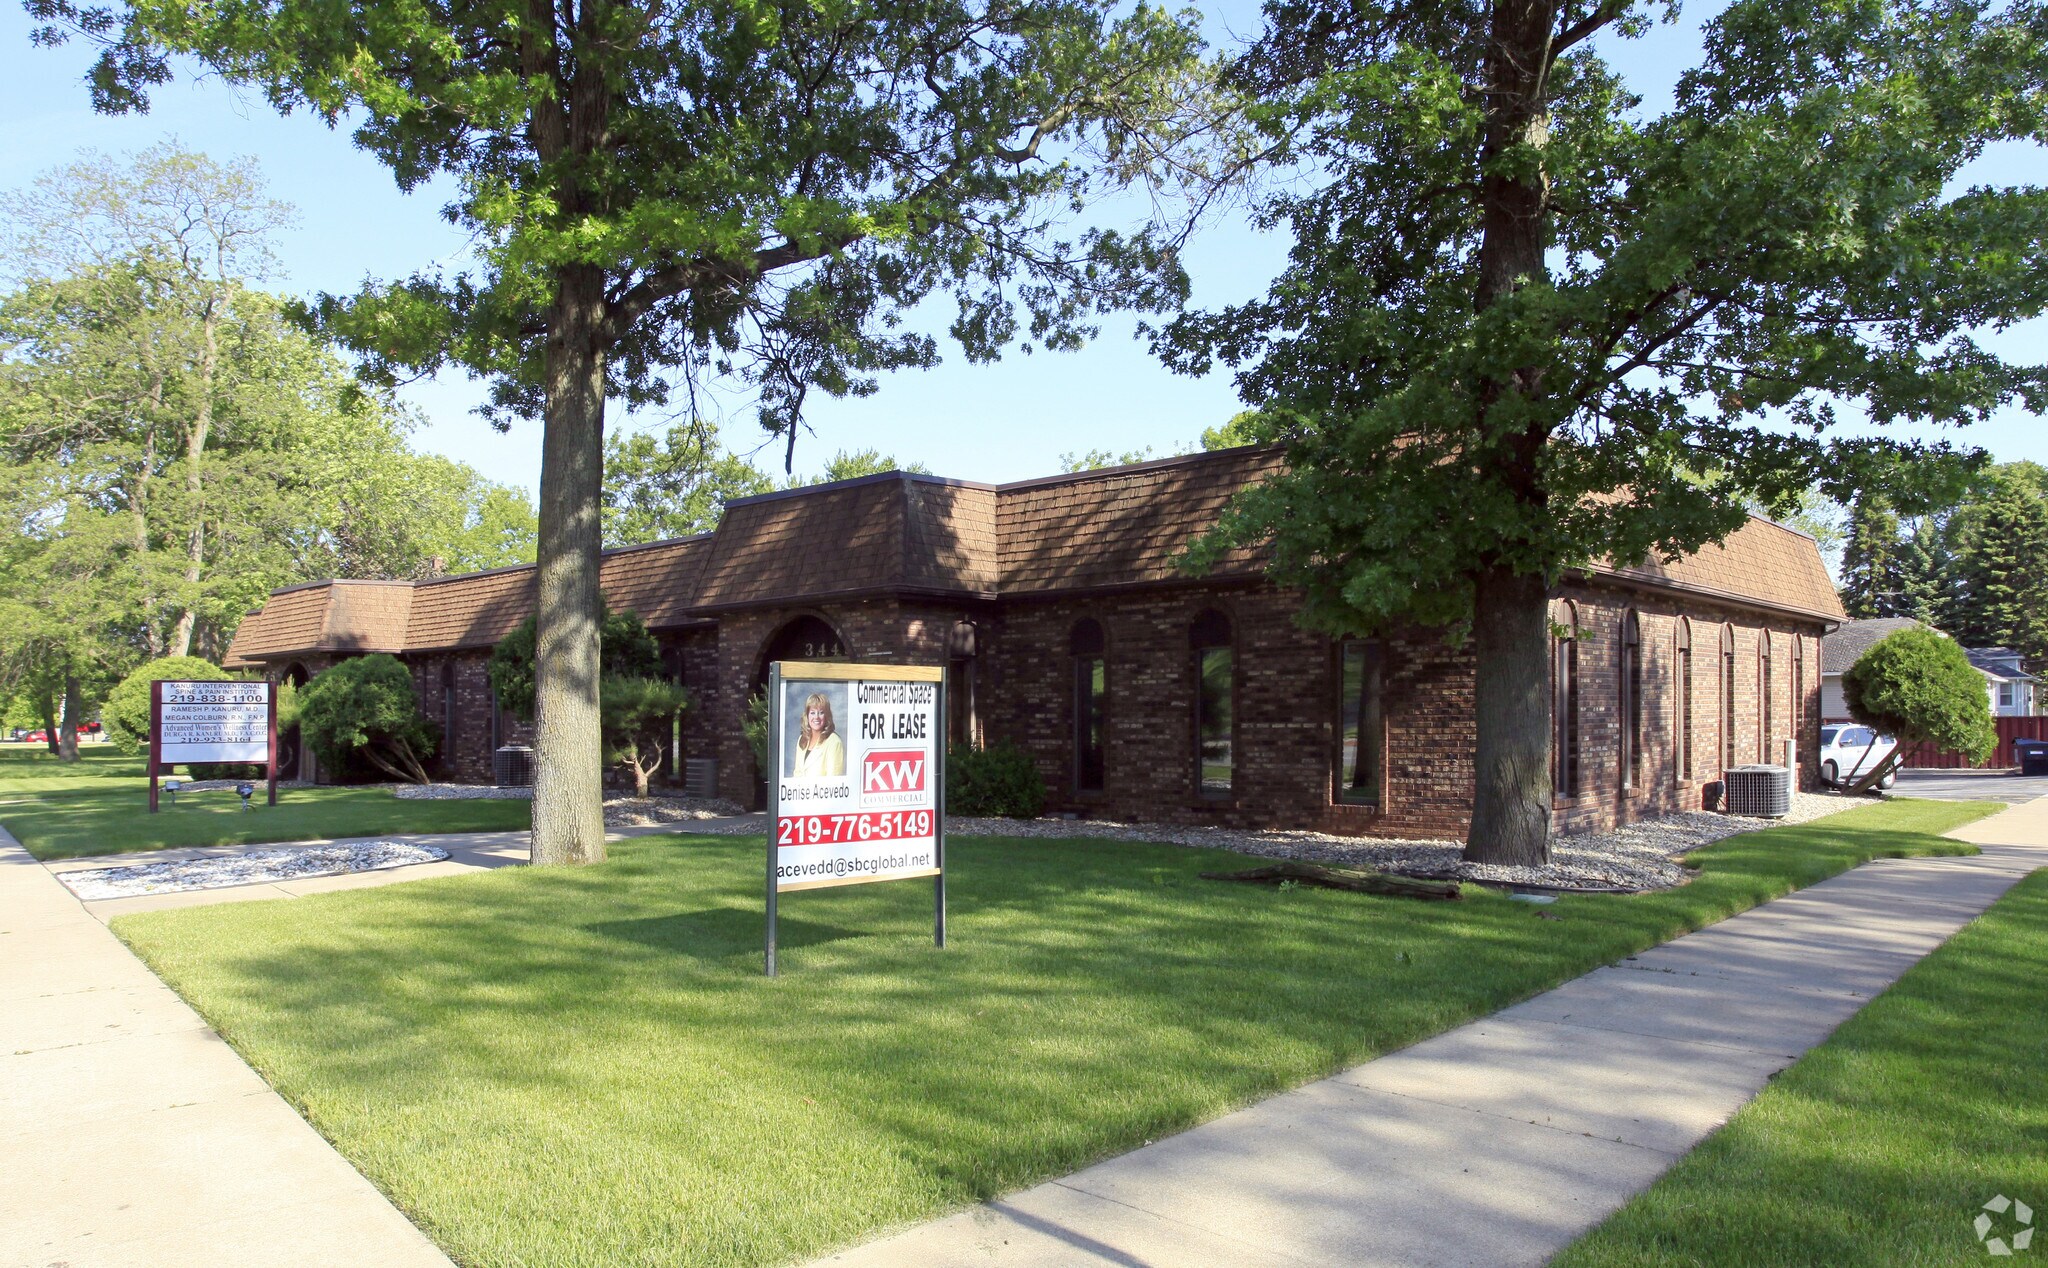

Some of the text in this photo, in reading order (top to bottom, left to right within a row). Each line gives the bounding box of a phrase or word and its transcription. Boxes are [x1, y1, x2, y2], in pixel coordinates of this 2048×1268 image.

[805, 643, 839, 656] 344
[170, 694, 262, 702] 219-838-1100
[857, 680, 931, 710] Commercial Space
[861, 713, 926, 739] FOR LEASE
[864, 760, 923, 791] KW
[780, 782, 849, 801] Denise Acevedo
[863, 793, 923, 804] COMMERCIAL
[779, 811, 930, 844] 219-776-5149
[777, 852, 930, 877] acevedd@sbcglobal.net
